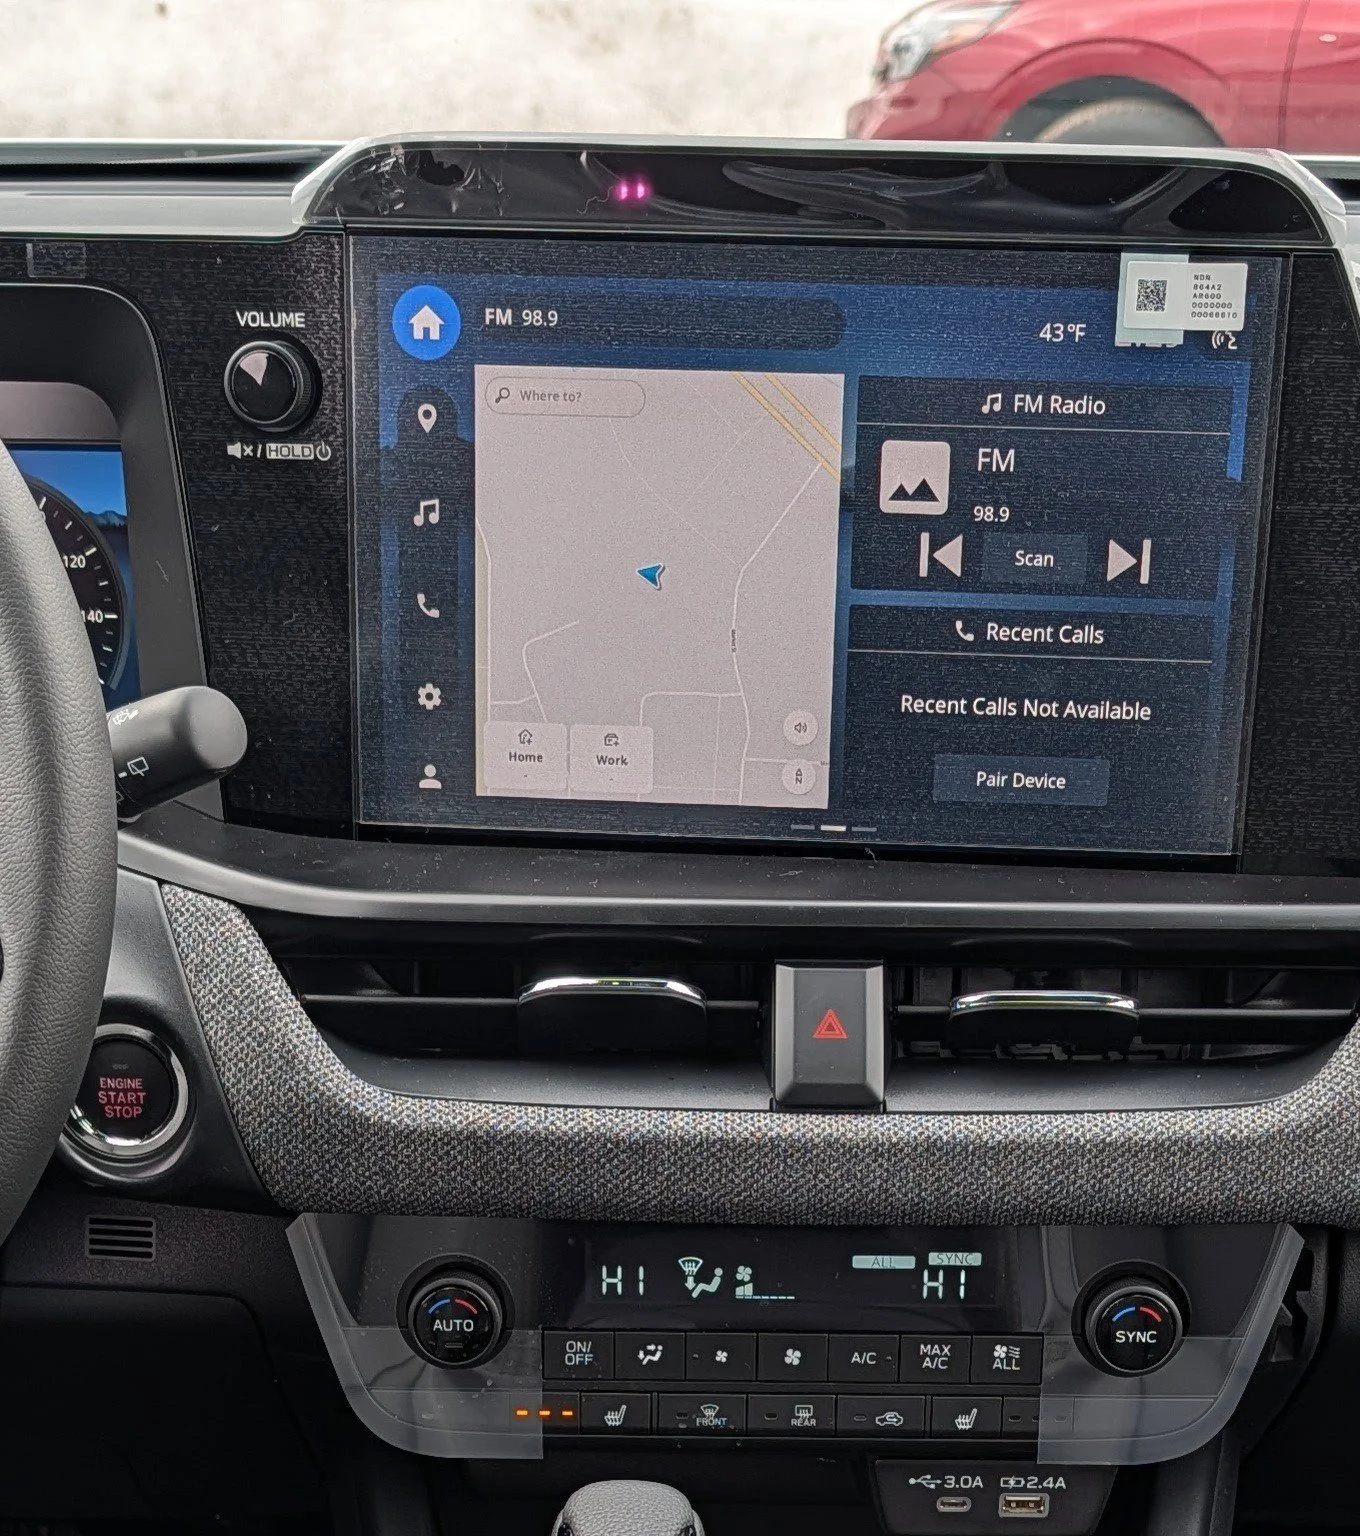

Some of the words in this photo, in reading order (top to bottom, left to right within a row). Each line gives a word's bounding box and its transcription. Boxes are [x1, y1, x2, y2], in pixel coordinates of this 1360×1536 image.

[236, 311, 306, 328] VOLUME
[484, 308, 513, 327] FM
[521, 309, 559, 328] 98.9
[1039, 321, 1086, 343] 43°F
[519, 389, 560, 403] Where
[565, 388, 583, 403] to?
[1014, 393, 1044, 414] FM
[1049, 394, 1106, 417] Radio
[268, 443, 312, 458] HOLD
[977, 448, 1016, 474] FM
[973, 505, 1010, 523] 98.9
[62, 555, 85, 568] 120
[1014, 549, 1055, 569] Scan
[986, 623, 1053, 644] Recent
[1059, 624, 1105, 645] Calls
[900, 695, 967, 717] Recent
[972, 696, 1018, 718] Calls
[1023, 699, 1059, 718] Not
[1063, 700, 1152, 721] Available
[508, 751, 543, 764] Home
[596, 754, 628, 767] Work
[976, 771, 1008, 789] Pair
[1013, 772, 1066, 790] Device
[99, 1077, 143, 1089] ENGINE
[98, 1091, 146, 1104] START
[105, 1106, 143, 1118] STOP
[871, 1256, 896, 1268] ALL
[937, 1253, 973, 1265] SYNC
[433, 1319, 474, 1332] AUTO
[1115, 1330, 1157, 1344] SYNC
[566, 1340, 592, 1354] ON/
[919, 1344, 951, 1357] MAX
[565, 1351, 594, 1366] OFF
[850, 1351, 877, 1366] A/C
[922, 1355, 948, 1371] A/C
[992, 1357, 1021, 1371] ALL
[696, 1416, 726, 1427] FRONT
[790, 1416, 816, 1428] REAR
[944, 1475, 984, 1490] 3.0A
[1027, 1476, 1066, 1490] 2.4A
